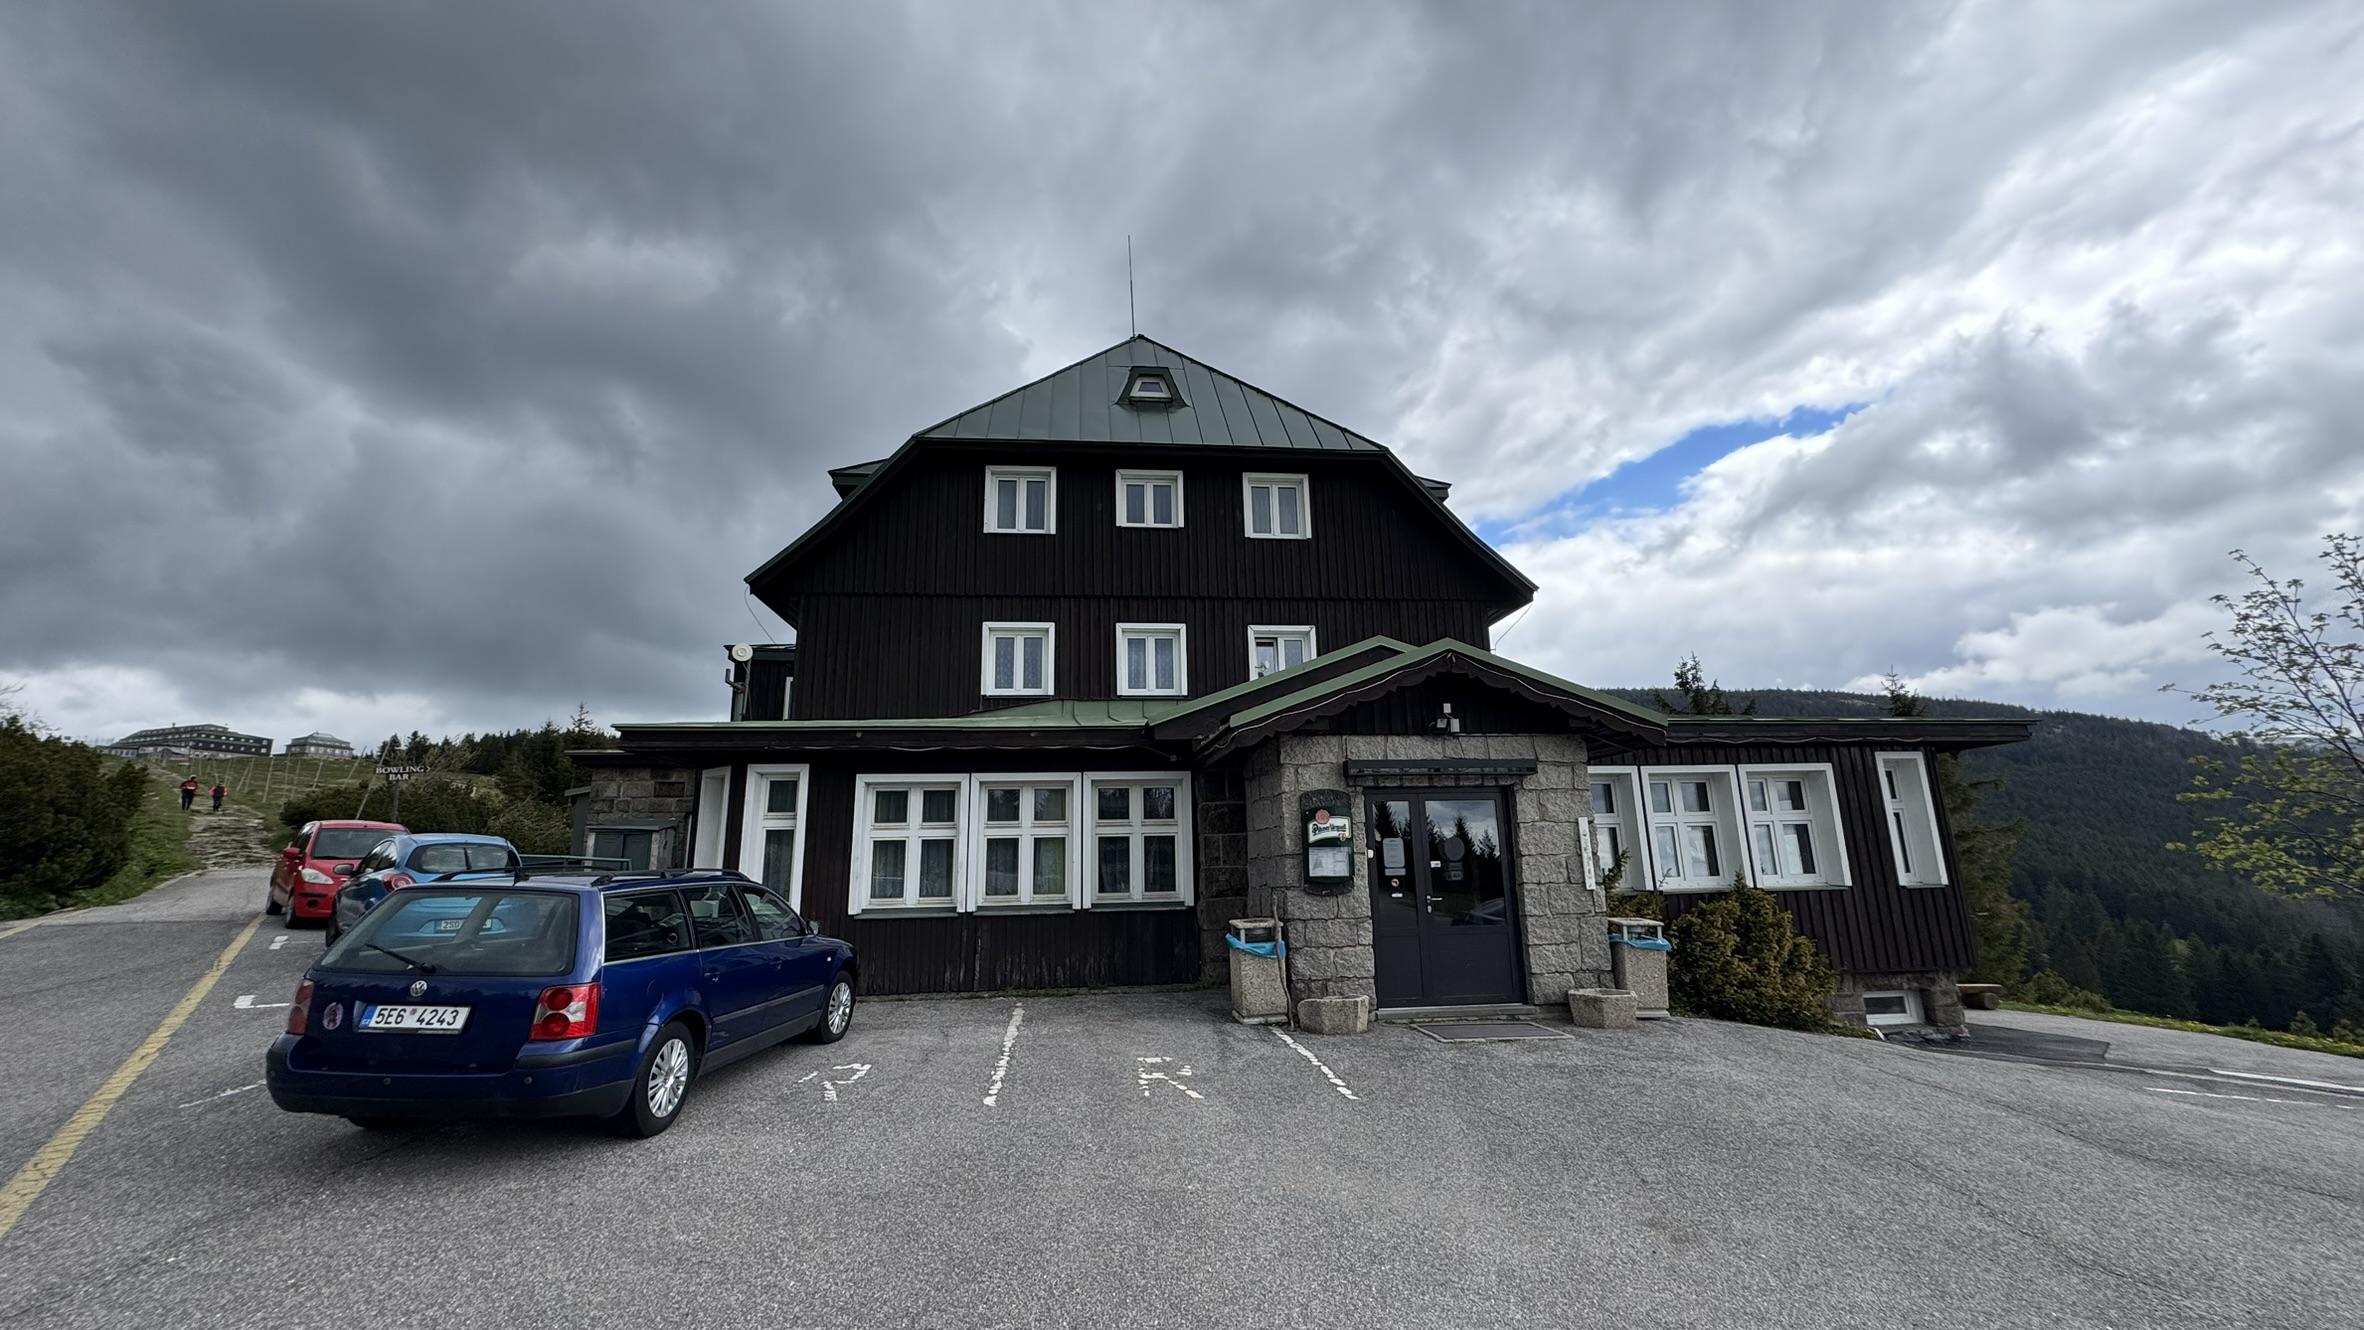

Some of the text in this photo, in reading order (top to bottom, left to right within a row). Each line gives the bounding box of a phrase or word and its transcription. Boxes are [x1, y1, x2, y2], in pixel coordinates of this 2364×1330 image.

[376, 766, 425, 774] BOWLING
[375, 1007, 459, 1026] 5E6 4243
